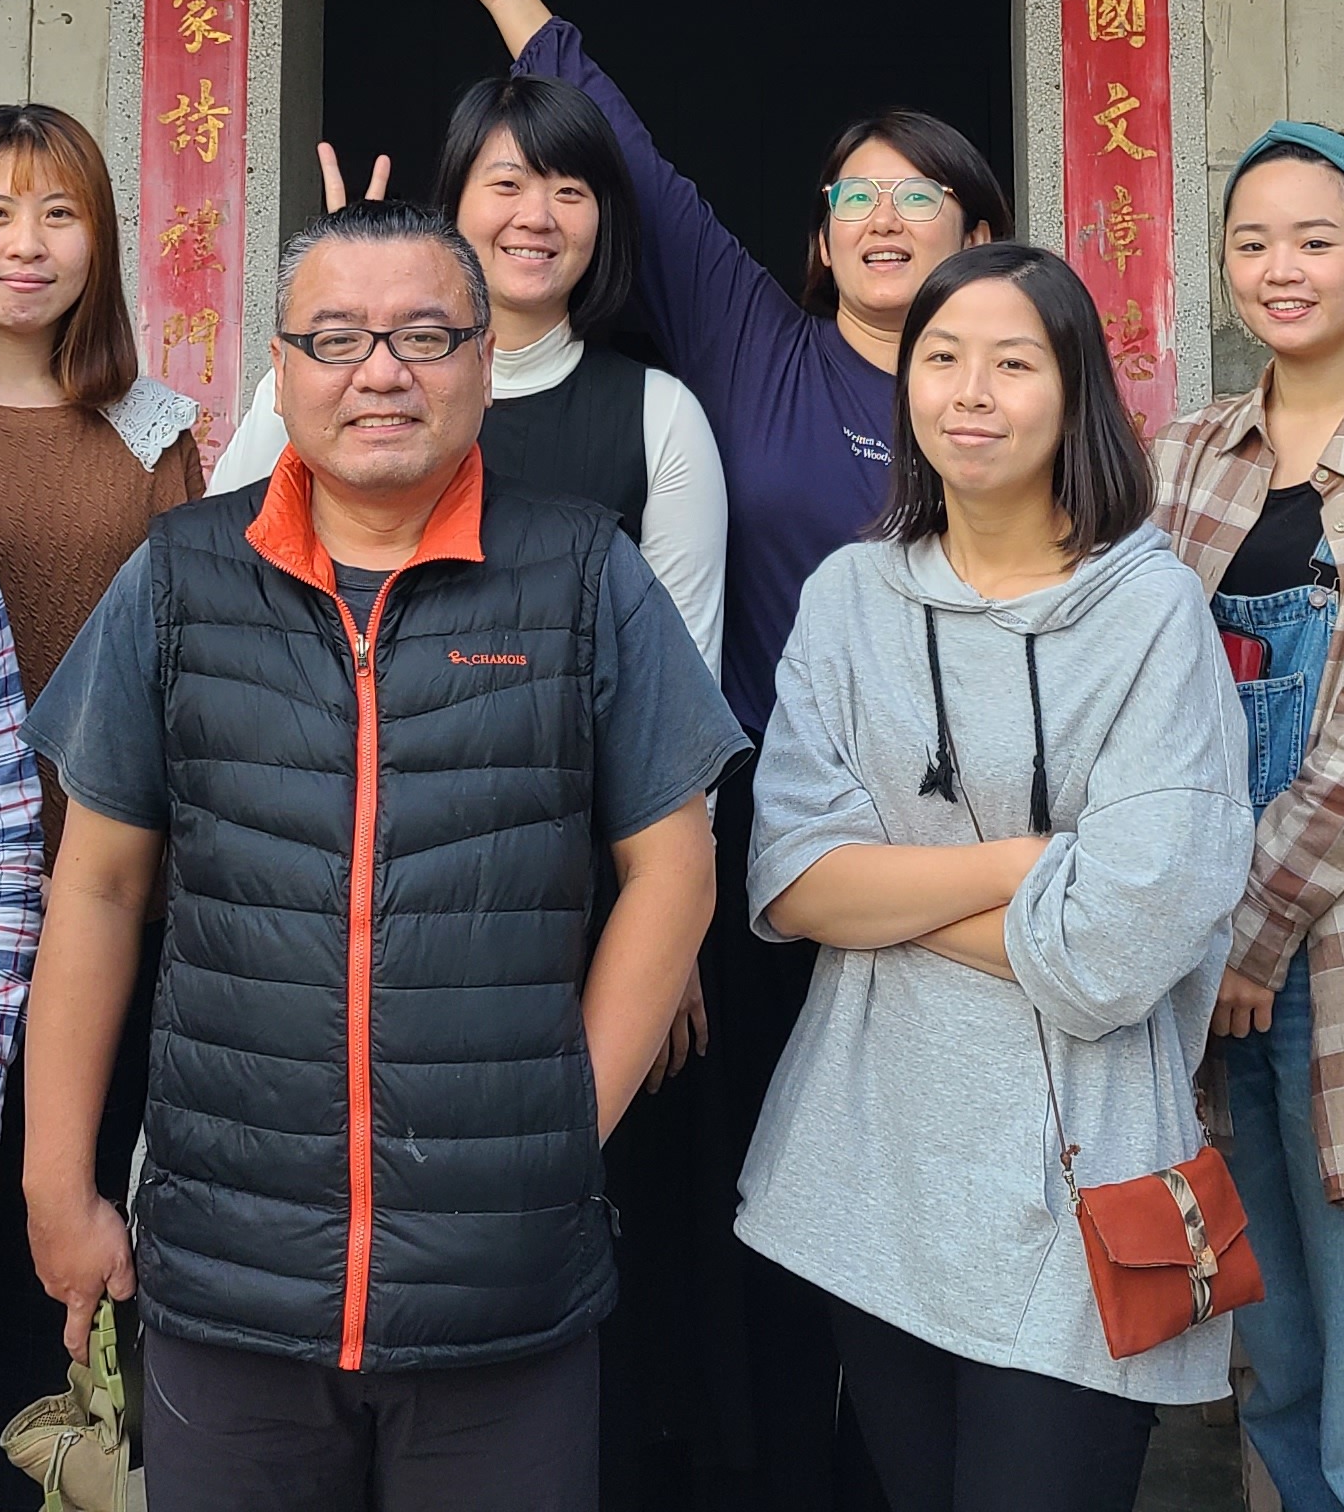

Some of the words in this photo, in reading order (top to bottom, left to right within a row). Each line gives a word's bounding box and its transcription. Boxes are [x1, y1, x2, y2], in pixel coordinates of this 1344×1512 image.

[842, 426, 874, 446] Written
[851, 443, 862, 457] by
[471, 654, 527, 665] CHAMOIS
